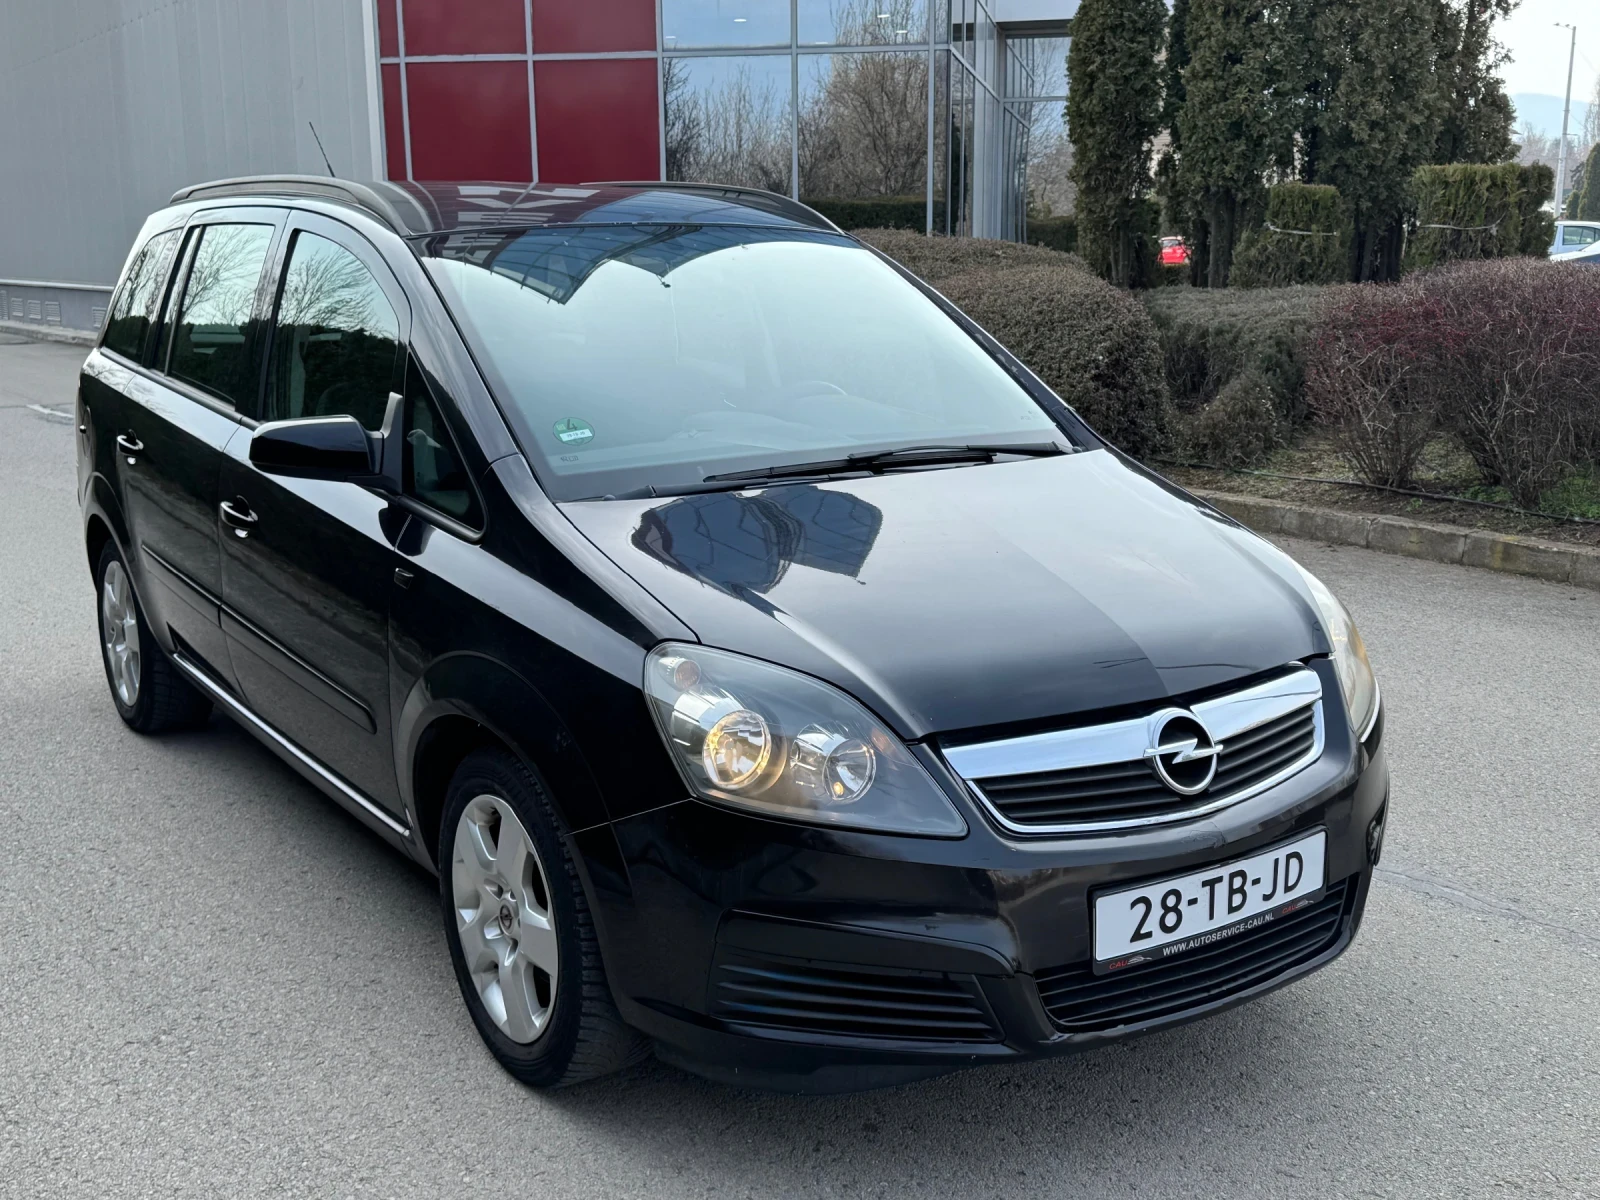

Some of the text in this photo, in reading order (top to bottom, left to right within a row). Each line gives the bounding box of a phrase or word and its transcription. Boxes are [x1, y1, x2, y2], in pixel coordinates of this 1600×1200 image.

[1129, 851, 1304, 943] 28-TB-JD
[1162, 913, 1275, 956] WWW.AUTOSERVICE-CAU.NL
[1108, 960, 1129, 971] CAU
